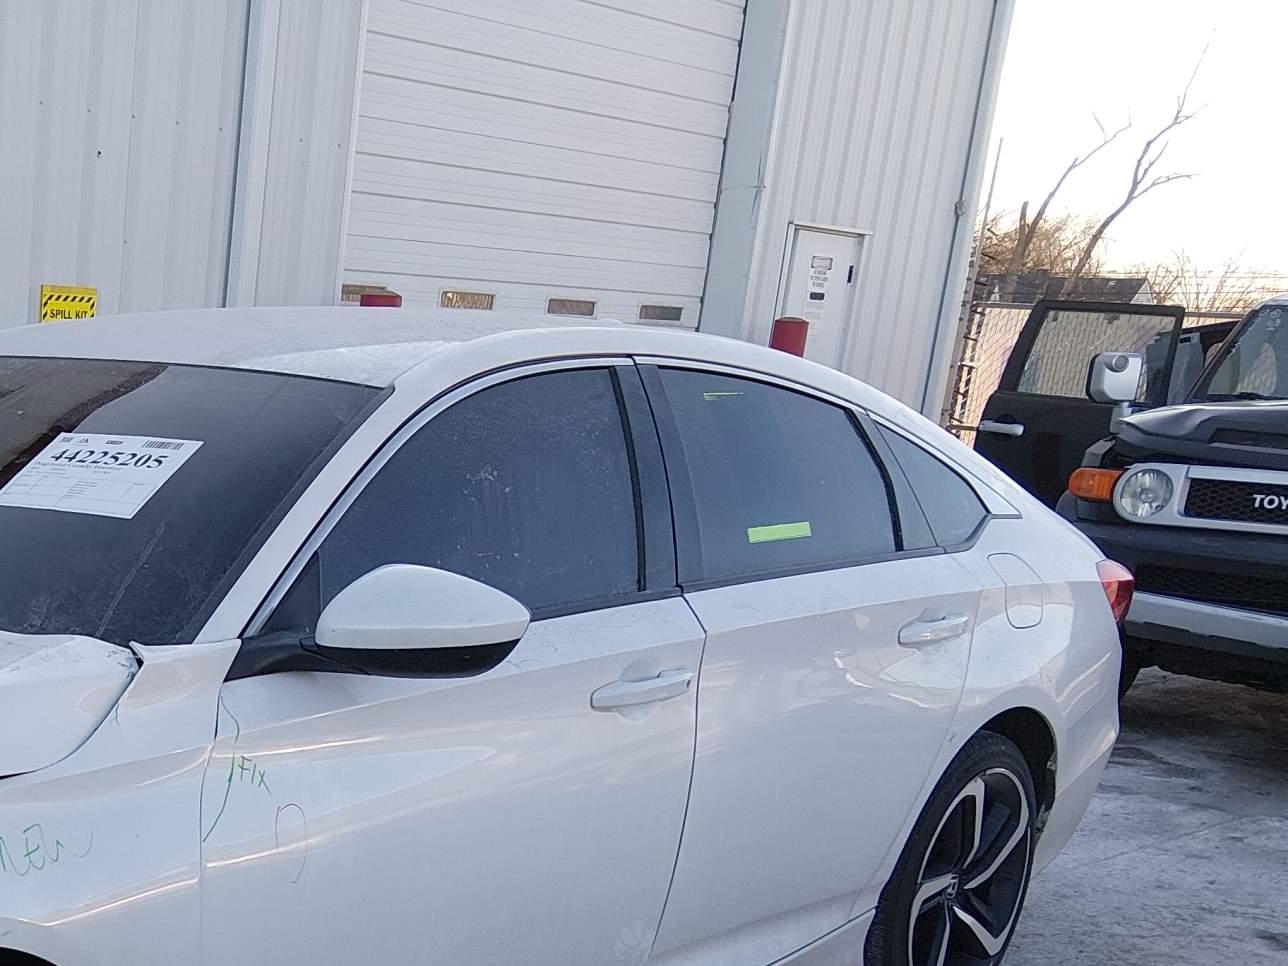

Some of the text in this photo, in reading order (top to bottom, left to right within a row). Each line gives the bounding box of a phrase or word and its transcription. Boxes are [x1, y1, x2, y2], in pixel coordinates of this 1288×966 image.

[49, 309, 88, 319] SPILL KIT
[51, 448, 170, 470] 44225205
